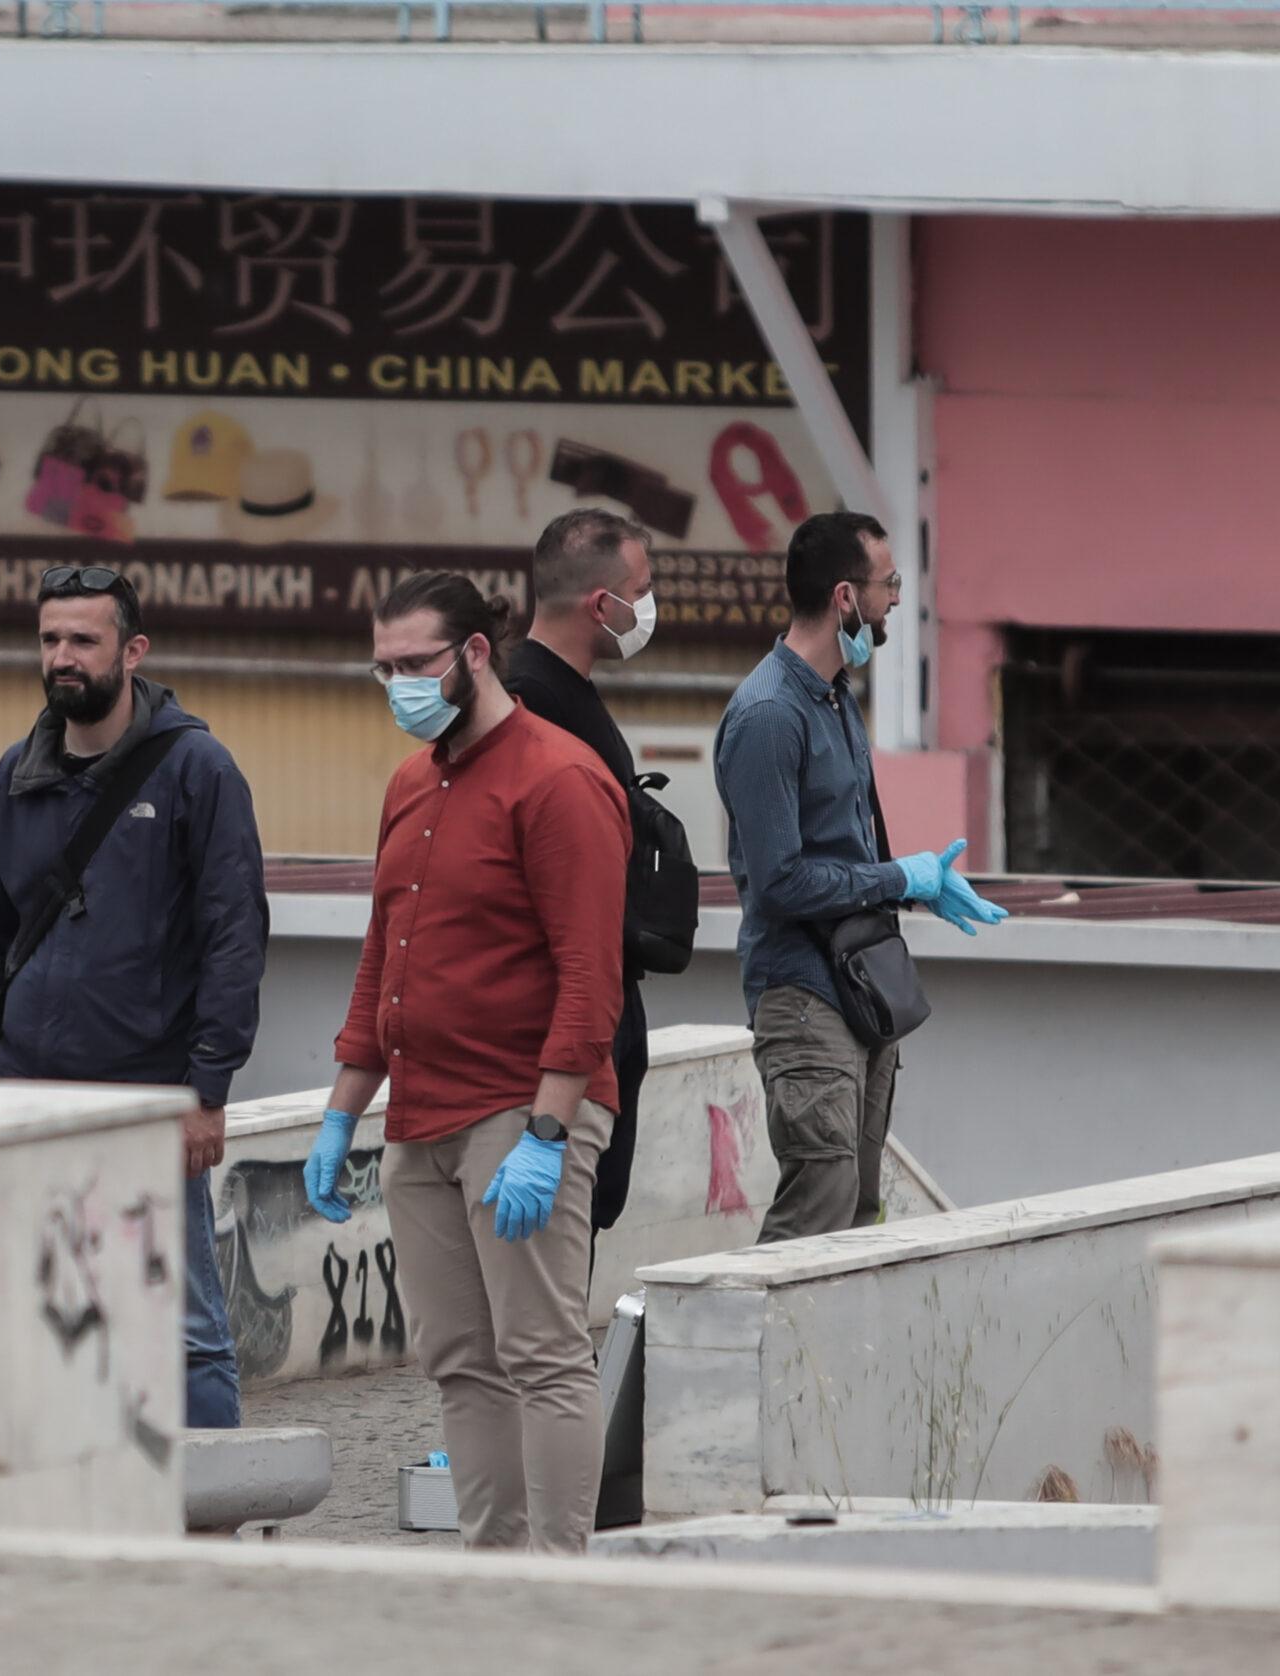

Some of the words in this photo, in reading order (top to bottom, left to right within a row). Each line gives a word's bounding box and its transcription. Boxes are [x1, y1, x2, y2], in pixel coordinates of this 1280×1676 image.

[141, 349, 310, 389] HUAN
[369, 354, 562, 393] CHINA
[580, 358, 839, 397] MARKE
[91, 559, 313, 608] ΟΝΔΡΙΚΗ
